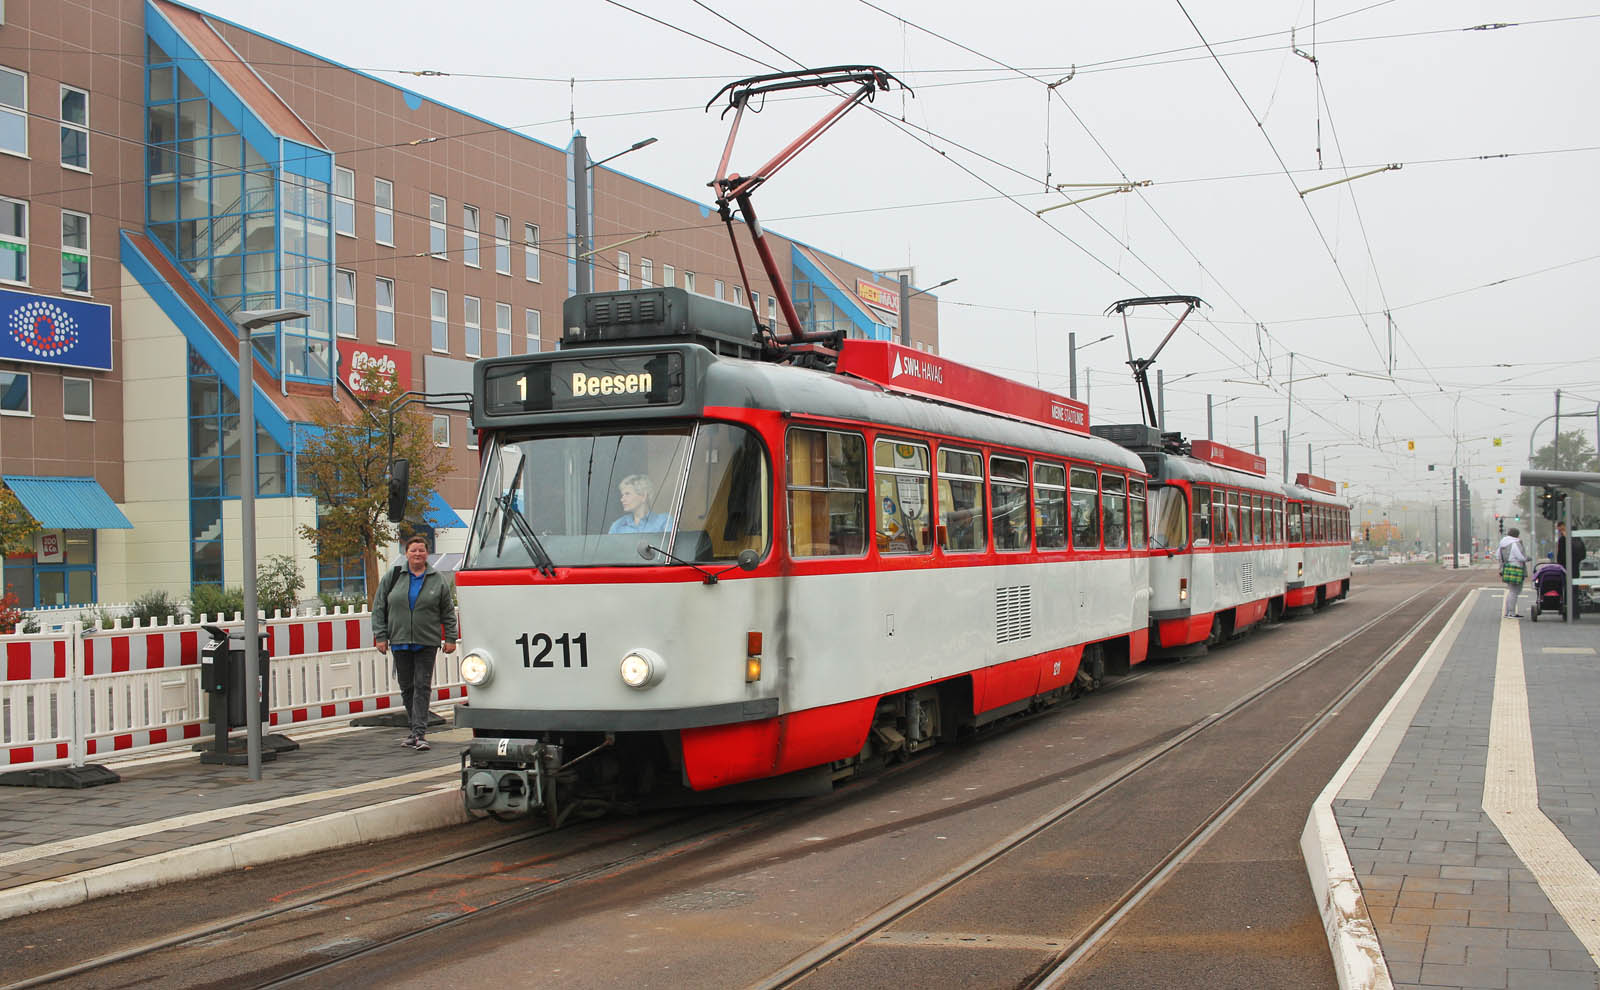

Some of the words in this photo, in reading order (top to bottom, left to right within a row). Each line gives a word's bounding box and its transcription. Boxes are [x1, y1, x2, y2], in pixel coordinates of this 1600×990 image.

[922, 360, 943, 384] HAVAG
[516, 376, 527, 400] 1
[572, 372, 652, 397] Beesen
[515, 632, 588, 668] 1211
